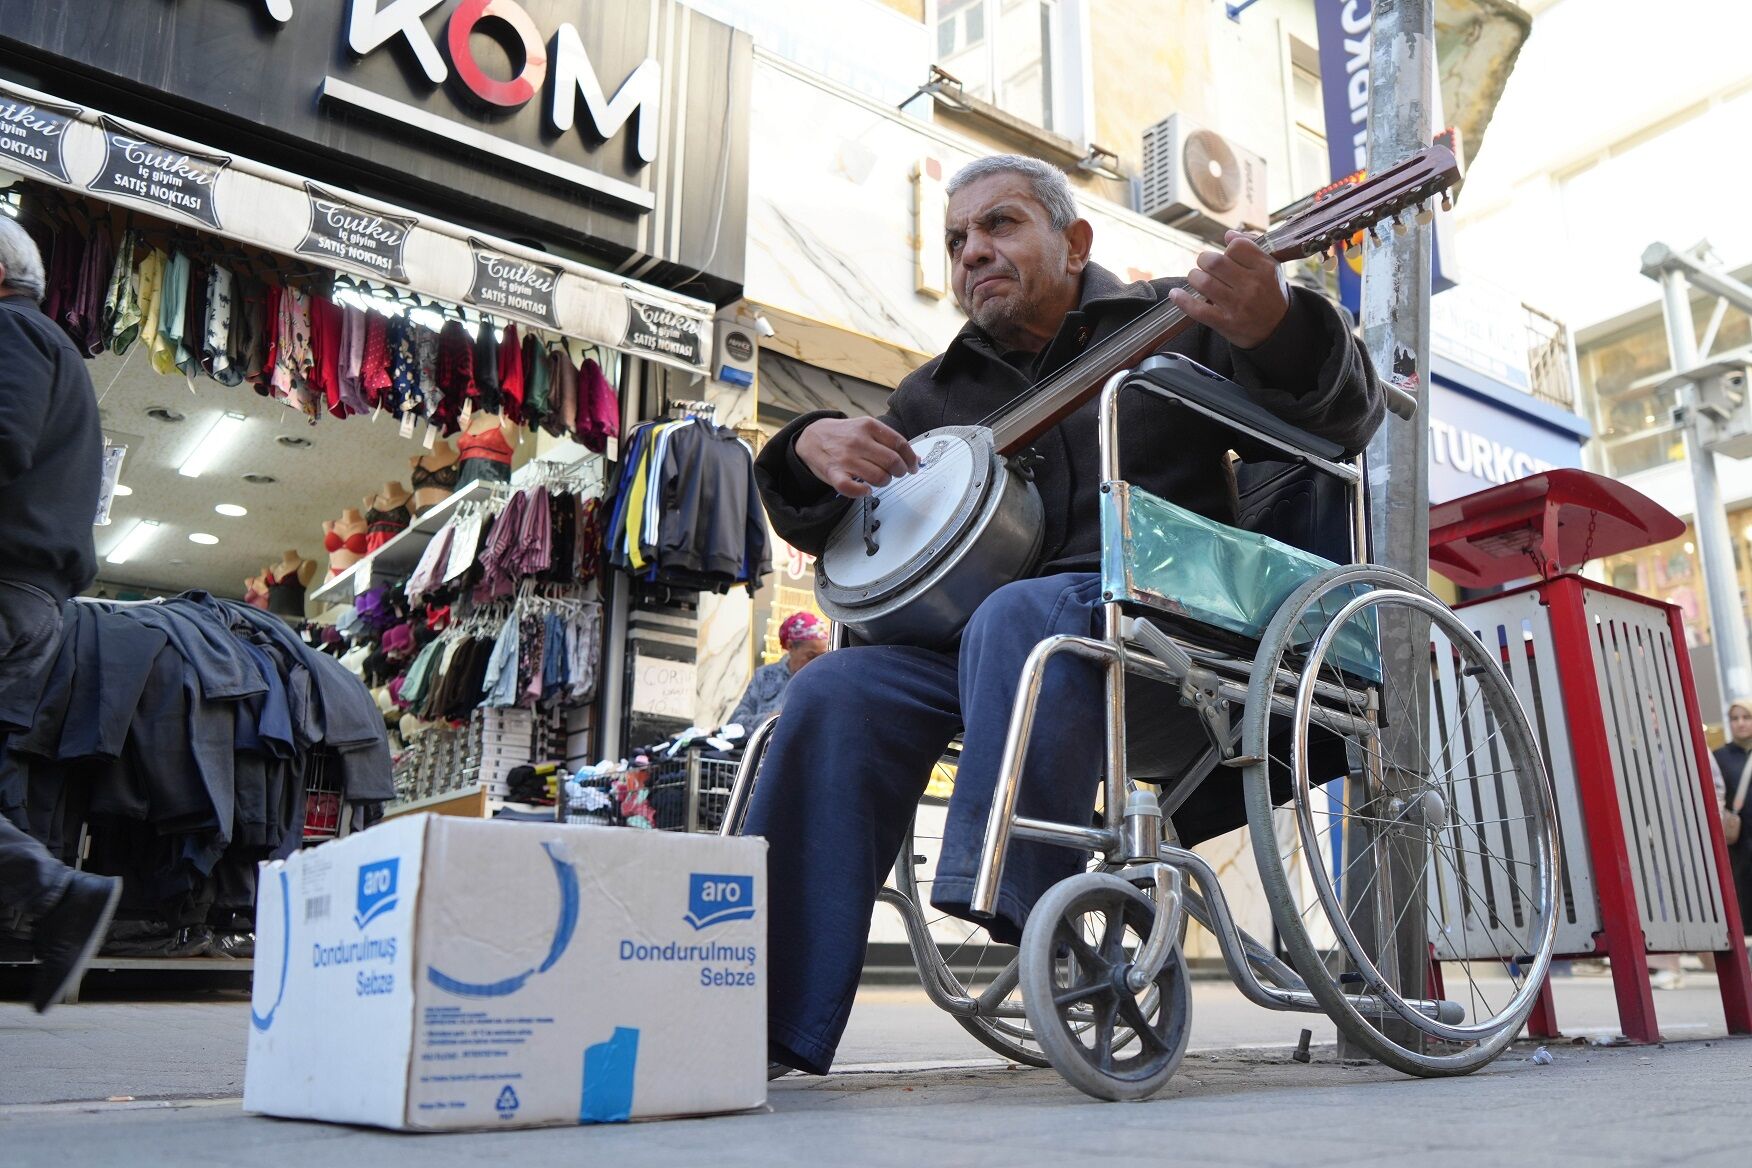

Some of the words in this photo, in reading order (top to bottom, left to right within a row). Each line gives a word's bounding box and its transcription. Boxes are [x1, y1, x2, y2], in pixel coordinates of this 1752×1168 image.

[0, 137, 48, 162] OKTASI
[114, 174, 147, 195] SATIŞ
[150, 185, 201, 210] NOKTASI
[152, 171, 183, 187] giyim
[318, 237, 347, 257] SATIŞ
[348, 247, 393, 270] NOKTASI
[350, 233, 377, 248] giyim
[481, 287, 506, 306] SATIŞ
[508, 294, 547, 315] NOKTASI
[508, 282, 532, 296] giyim
[633, 332, 657, 351] SATIŞ
[657, 339, 693, 357] NOKTASI
[1429, 417, 1558, 486] TURKC
[363, 868, 391, 896] aro
[701, 881, 741, 902] aro
[312, 935, 396, 968] Dondurulmuş
[619, 940, 756, 966] Dondurulmuş
[356, 968, 394, 996] Sebze
[700, 967, 756, 987] Sebze
